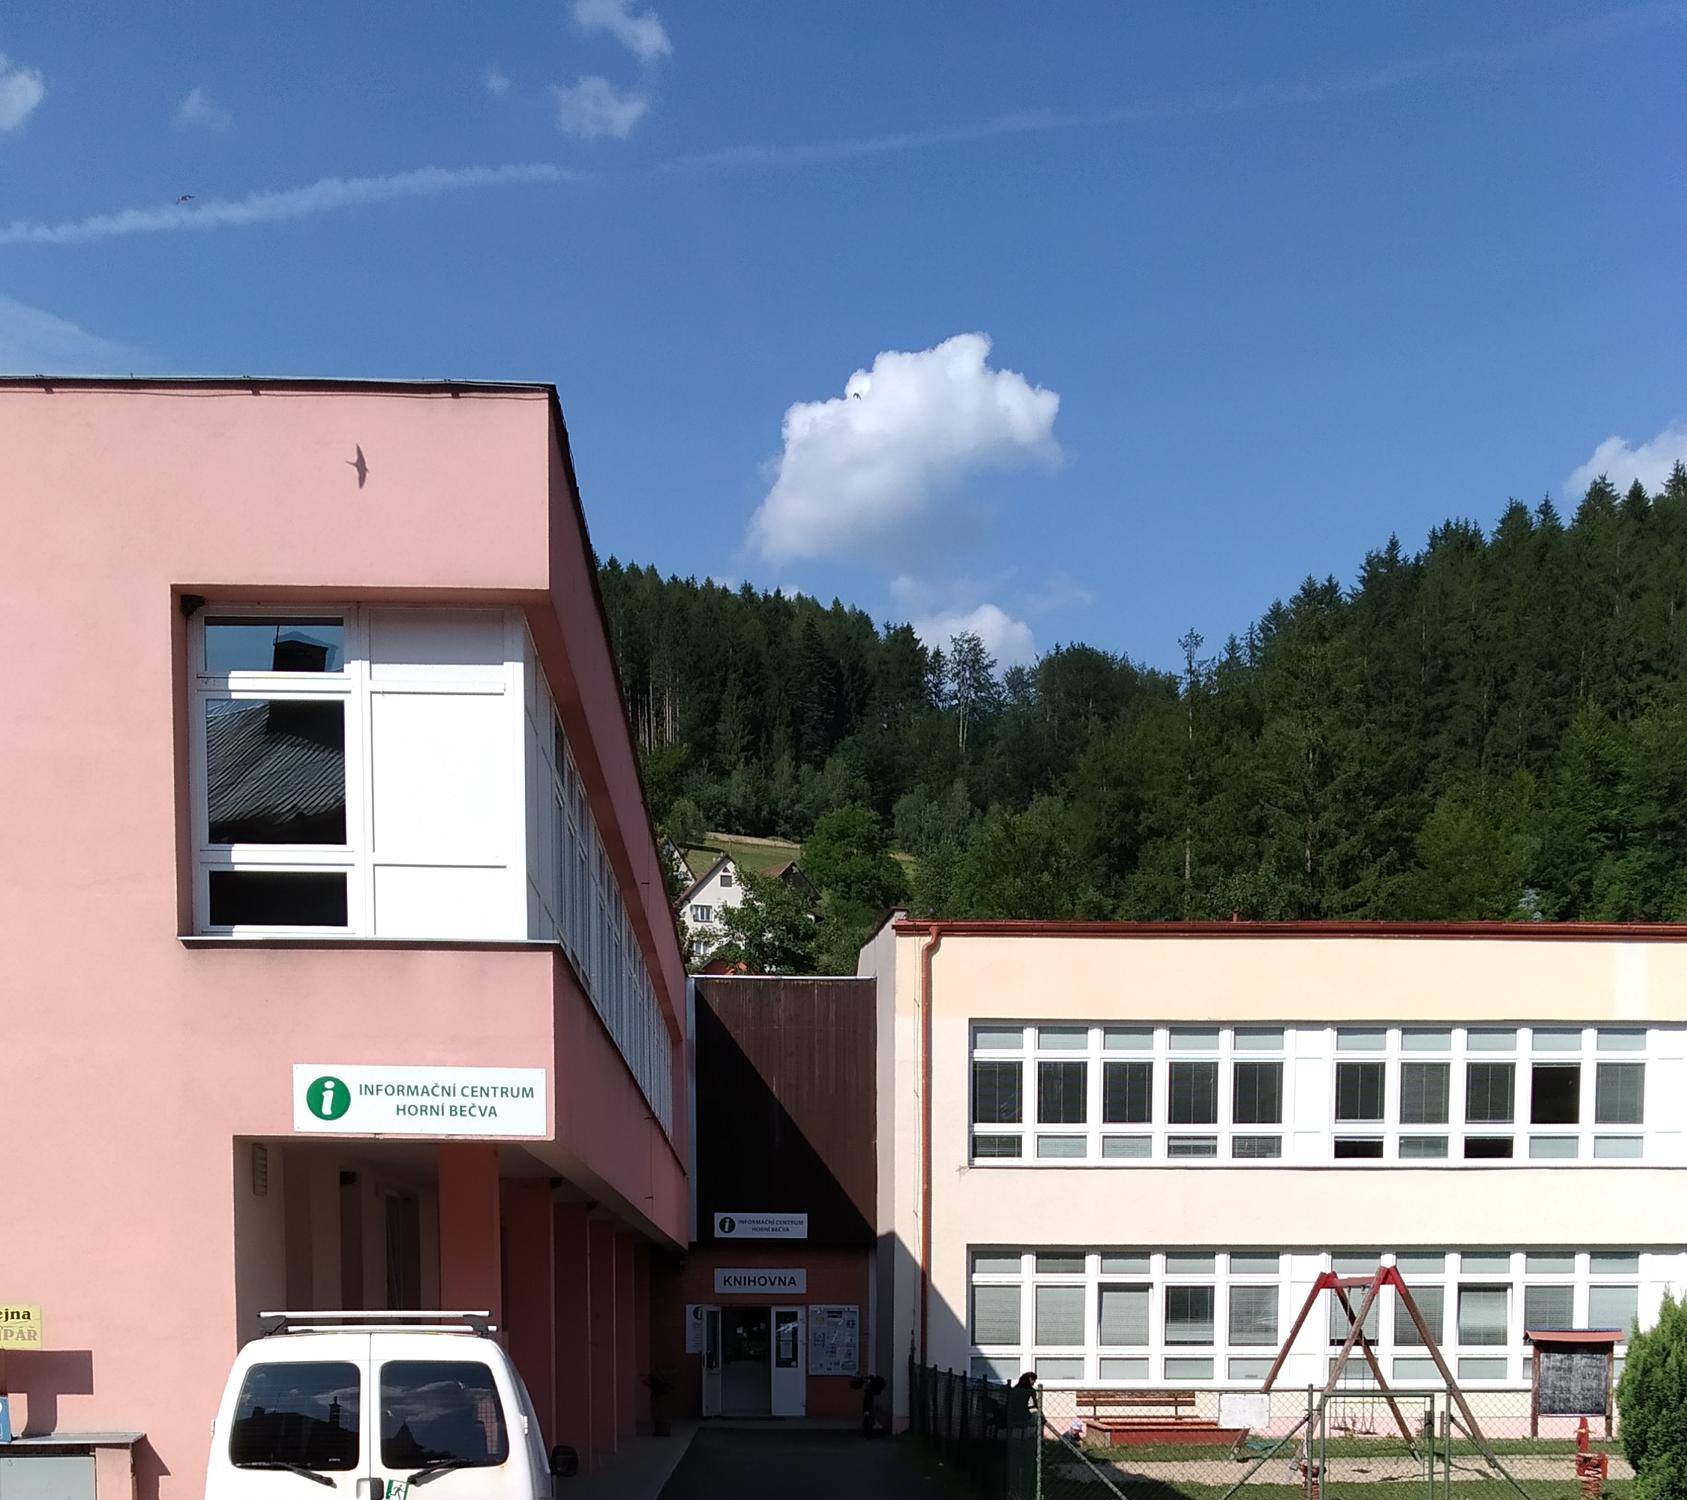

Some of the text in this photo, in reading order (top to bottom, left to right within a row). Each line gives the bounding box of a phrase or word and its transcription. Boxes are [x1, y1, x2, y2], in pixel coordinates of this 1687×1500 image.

[359, 1083, 535, 1099] INFORMAČNÍ CENTRUM
[396, 1103, 498, 1118] HORNÍ BEČVA
[723, 1275, 797, 1287] KNIHOVNA
